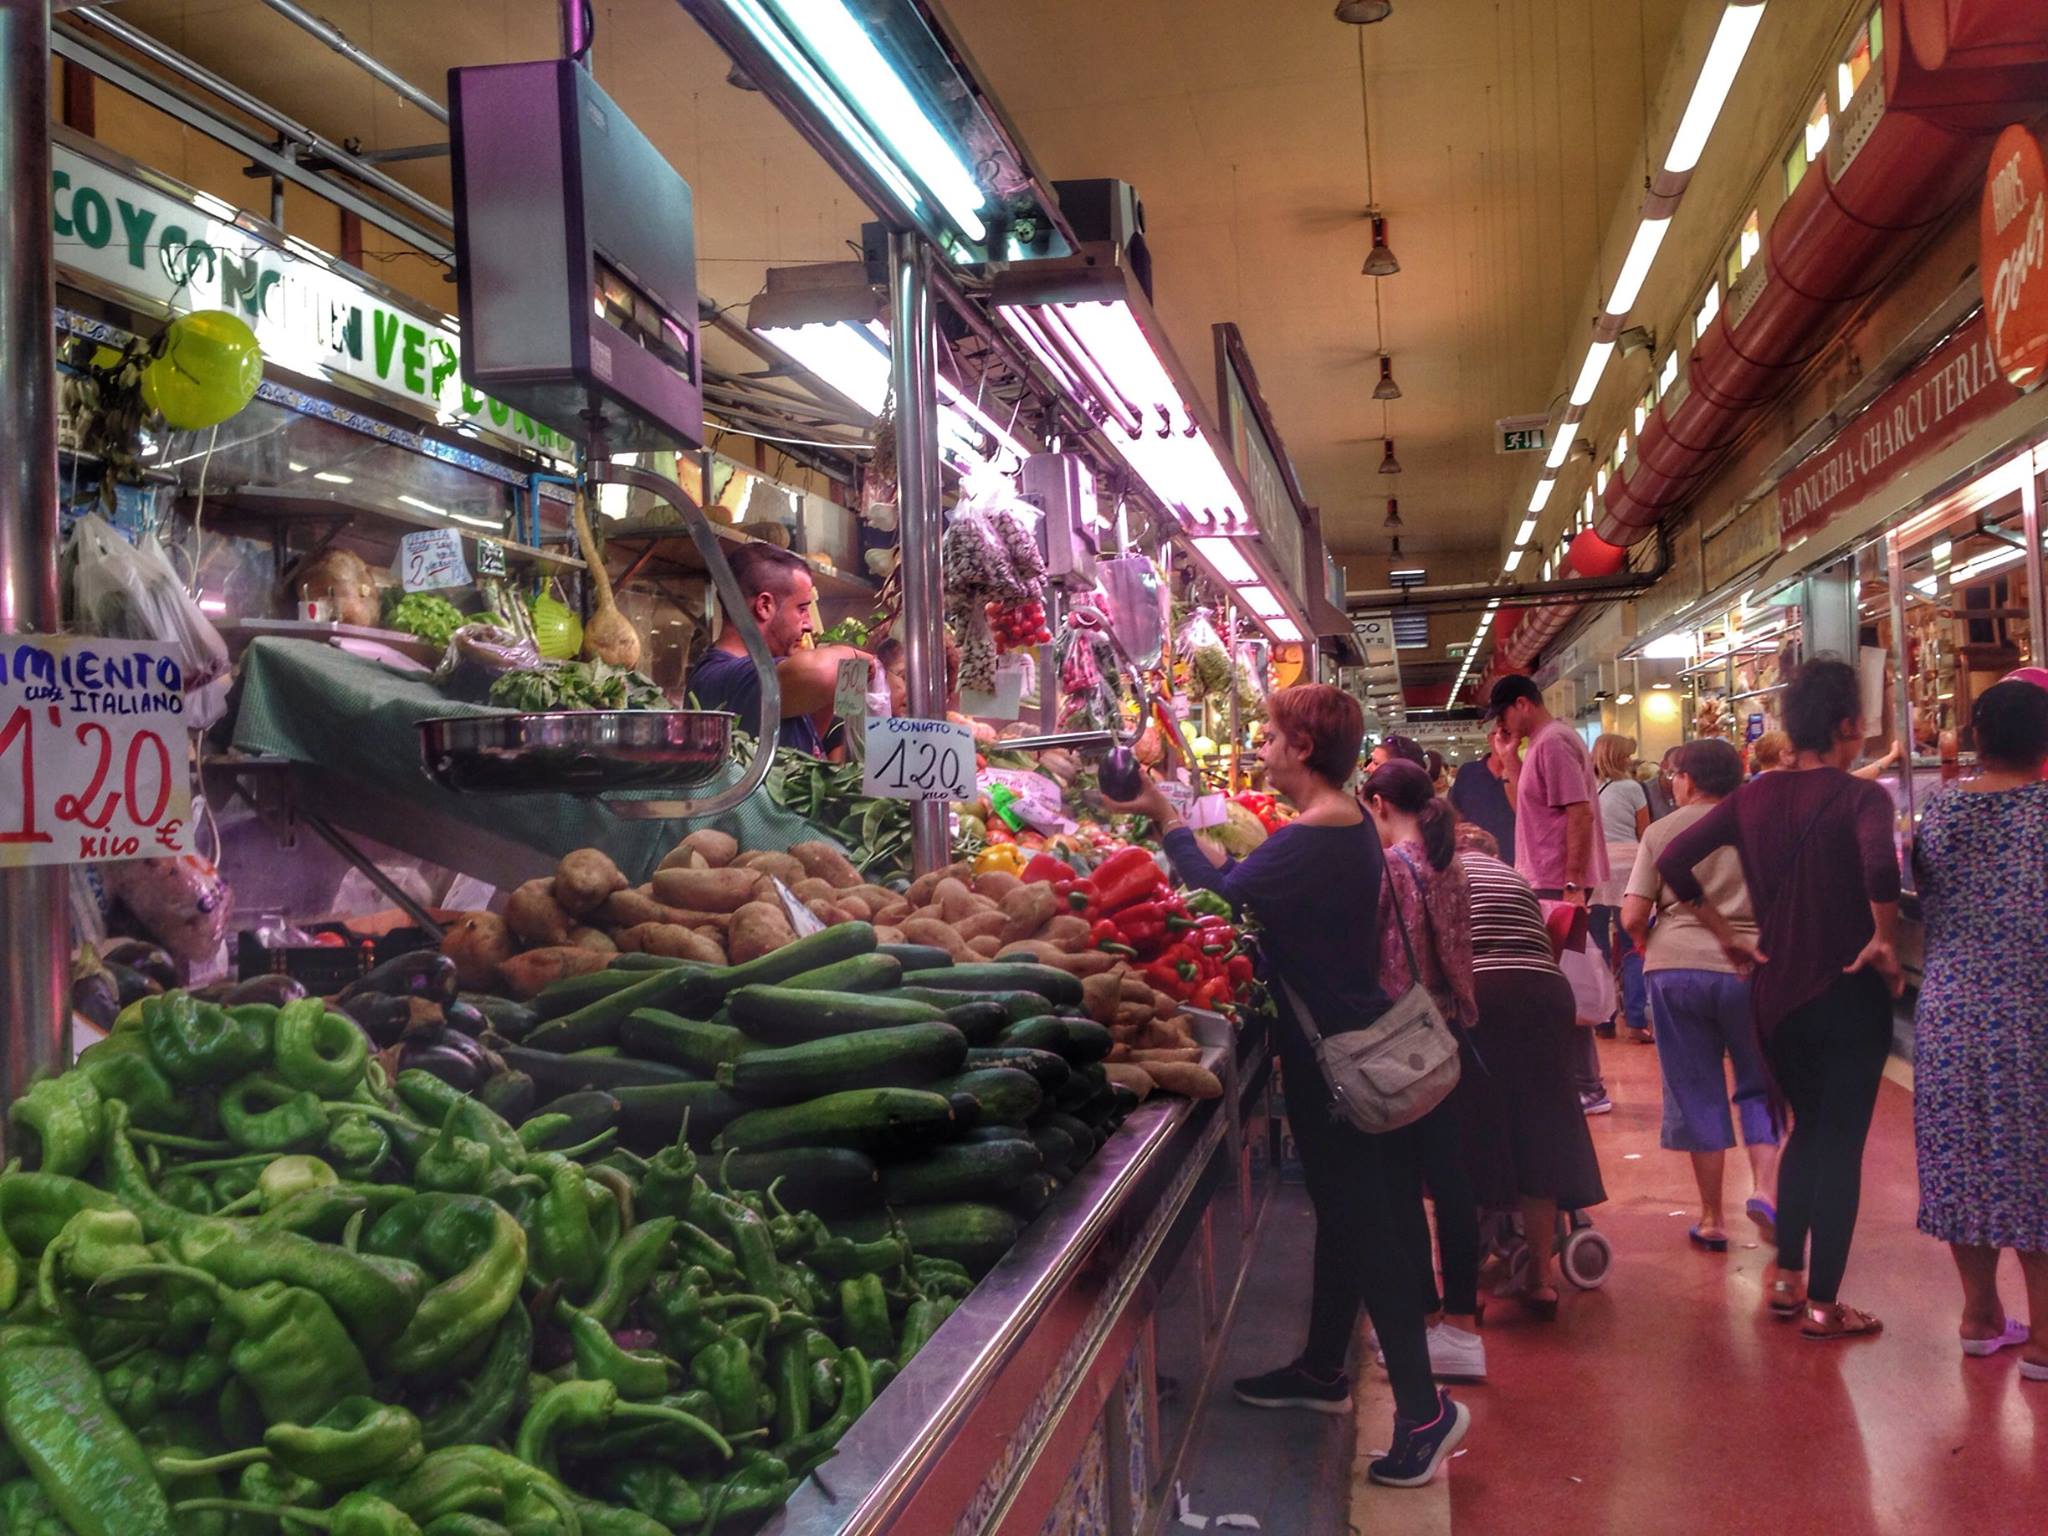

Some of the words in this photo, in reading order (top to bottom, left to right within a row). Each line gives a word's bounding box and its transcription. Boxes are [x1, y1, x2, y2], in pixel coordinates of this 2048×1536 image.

[70, 690, 183, 714] ITALIANO
[886, 717, 951, 735] BONIATO
[873, 737, 960, 790] 1'20
